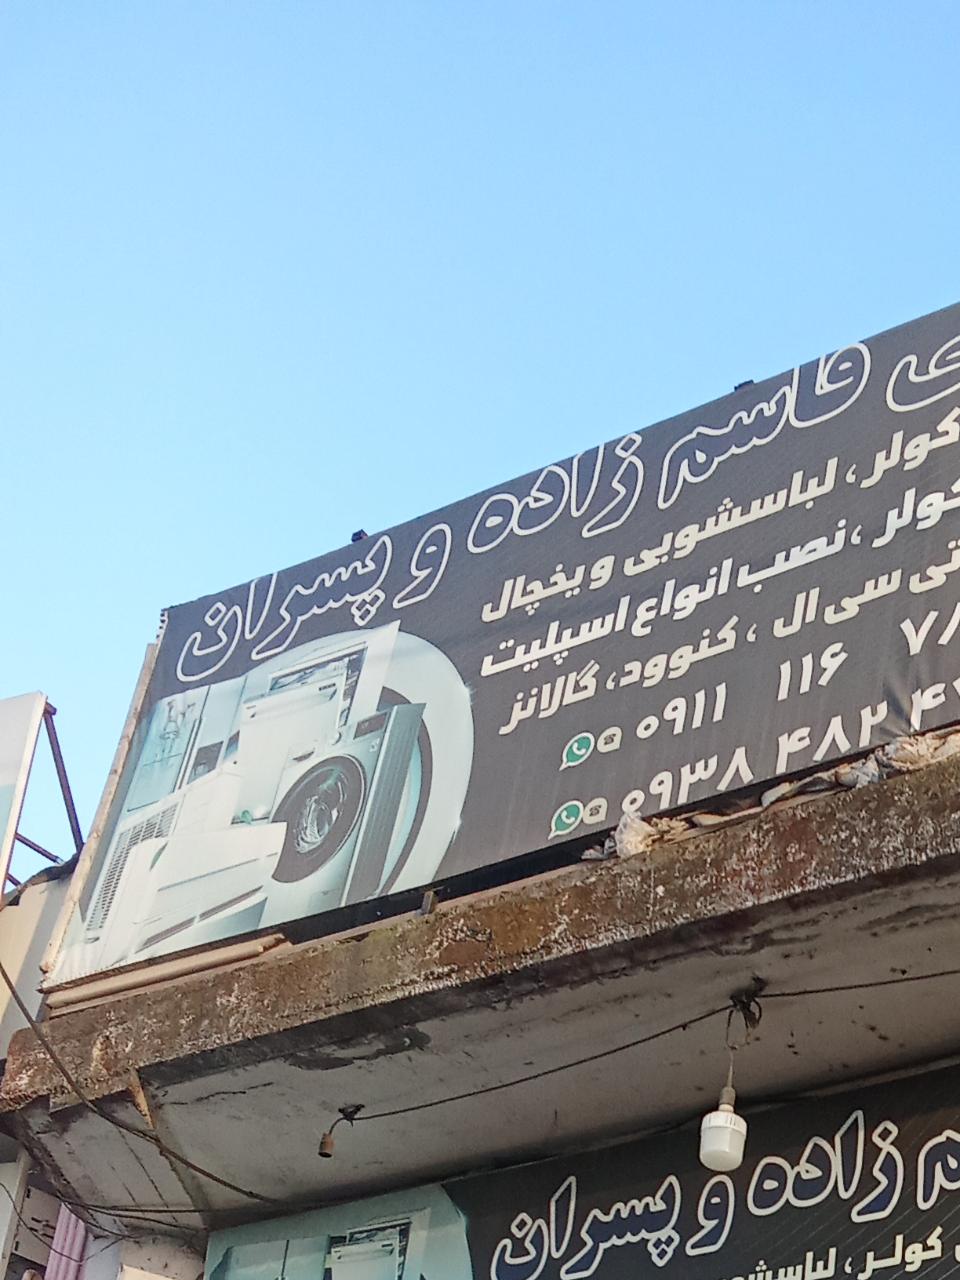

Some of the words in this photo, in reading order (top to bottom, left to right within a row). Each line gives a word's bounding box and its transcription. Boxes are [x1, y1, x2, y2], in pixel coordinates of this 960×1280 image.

[479, 595, 630, 677] اسپلیت
[631, 558, 733, 638] انواع
[823, 568, 902, 624] سی
[498, 659, 601, 735] گالانز
[747, 1109, 904, 1223] زاده
[685, 1174, 736, 1256] و
